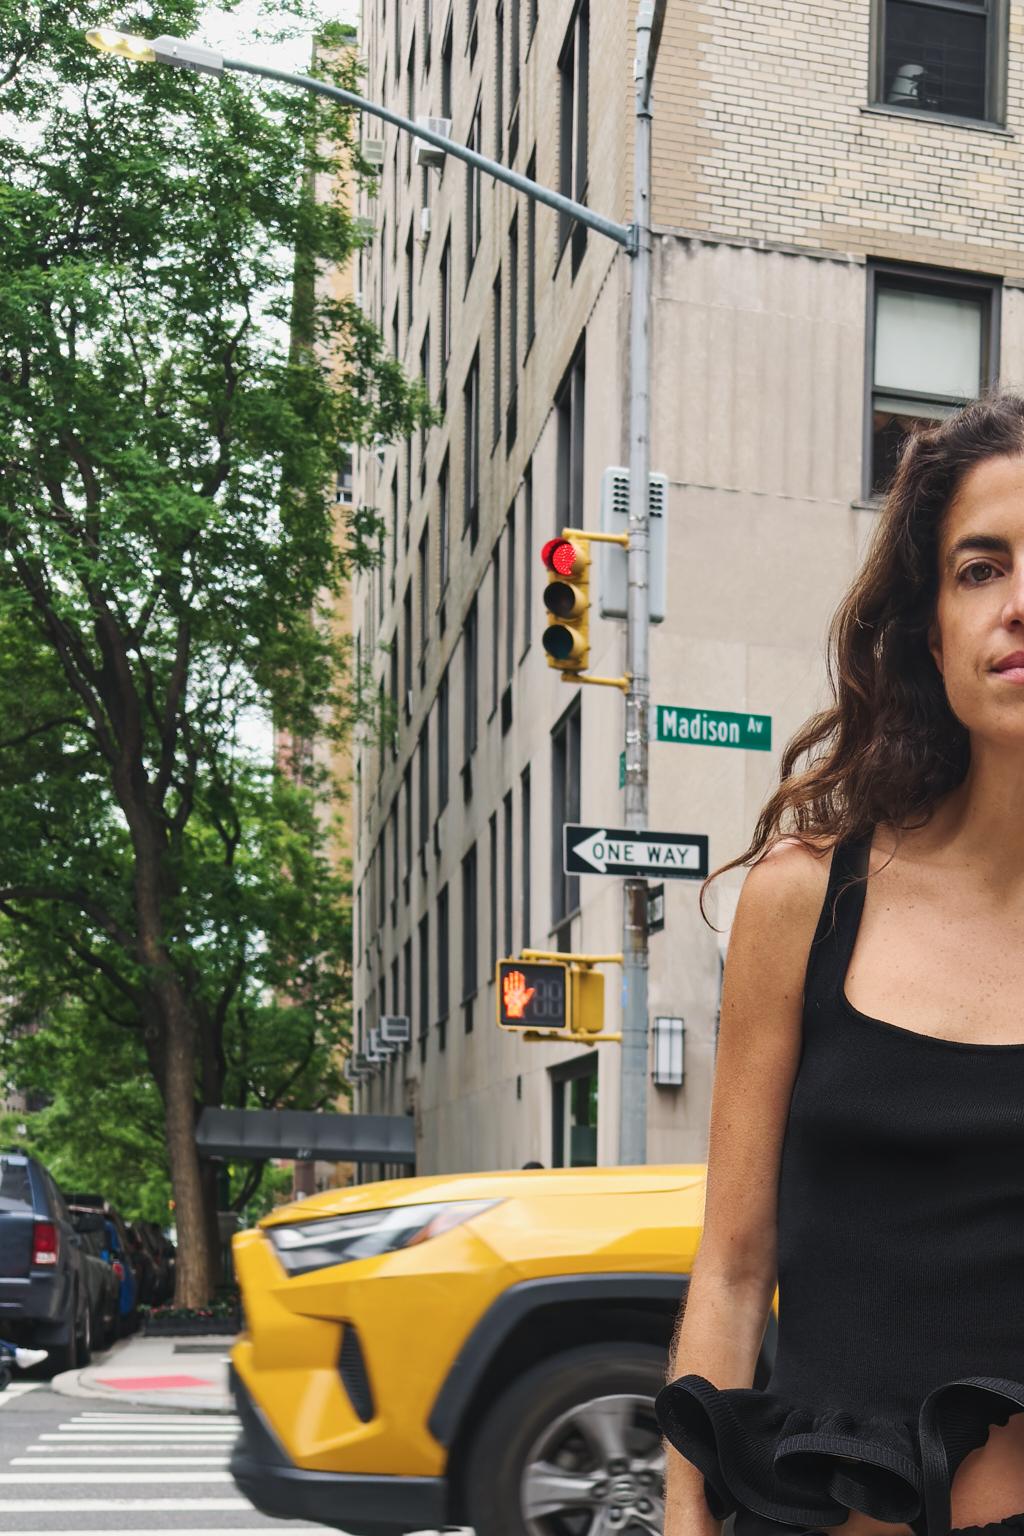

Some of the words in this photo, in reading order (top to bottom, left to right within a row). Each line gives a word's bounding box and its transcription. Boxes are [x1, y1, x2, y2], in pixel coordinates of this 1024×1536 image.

[662, 709, 740, 744] Madison
[747, 717, 763, 733] Av
[592, 842, 635, 862] ONE
[647, 846, 689, 865] WAY
